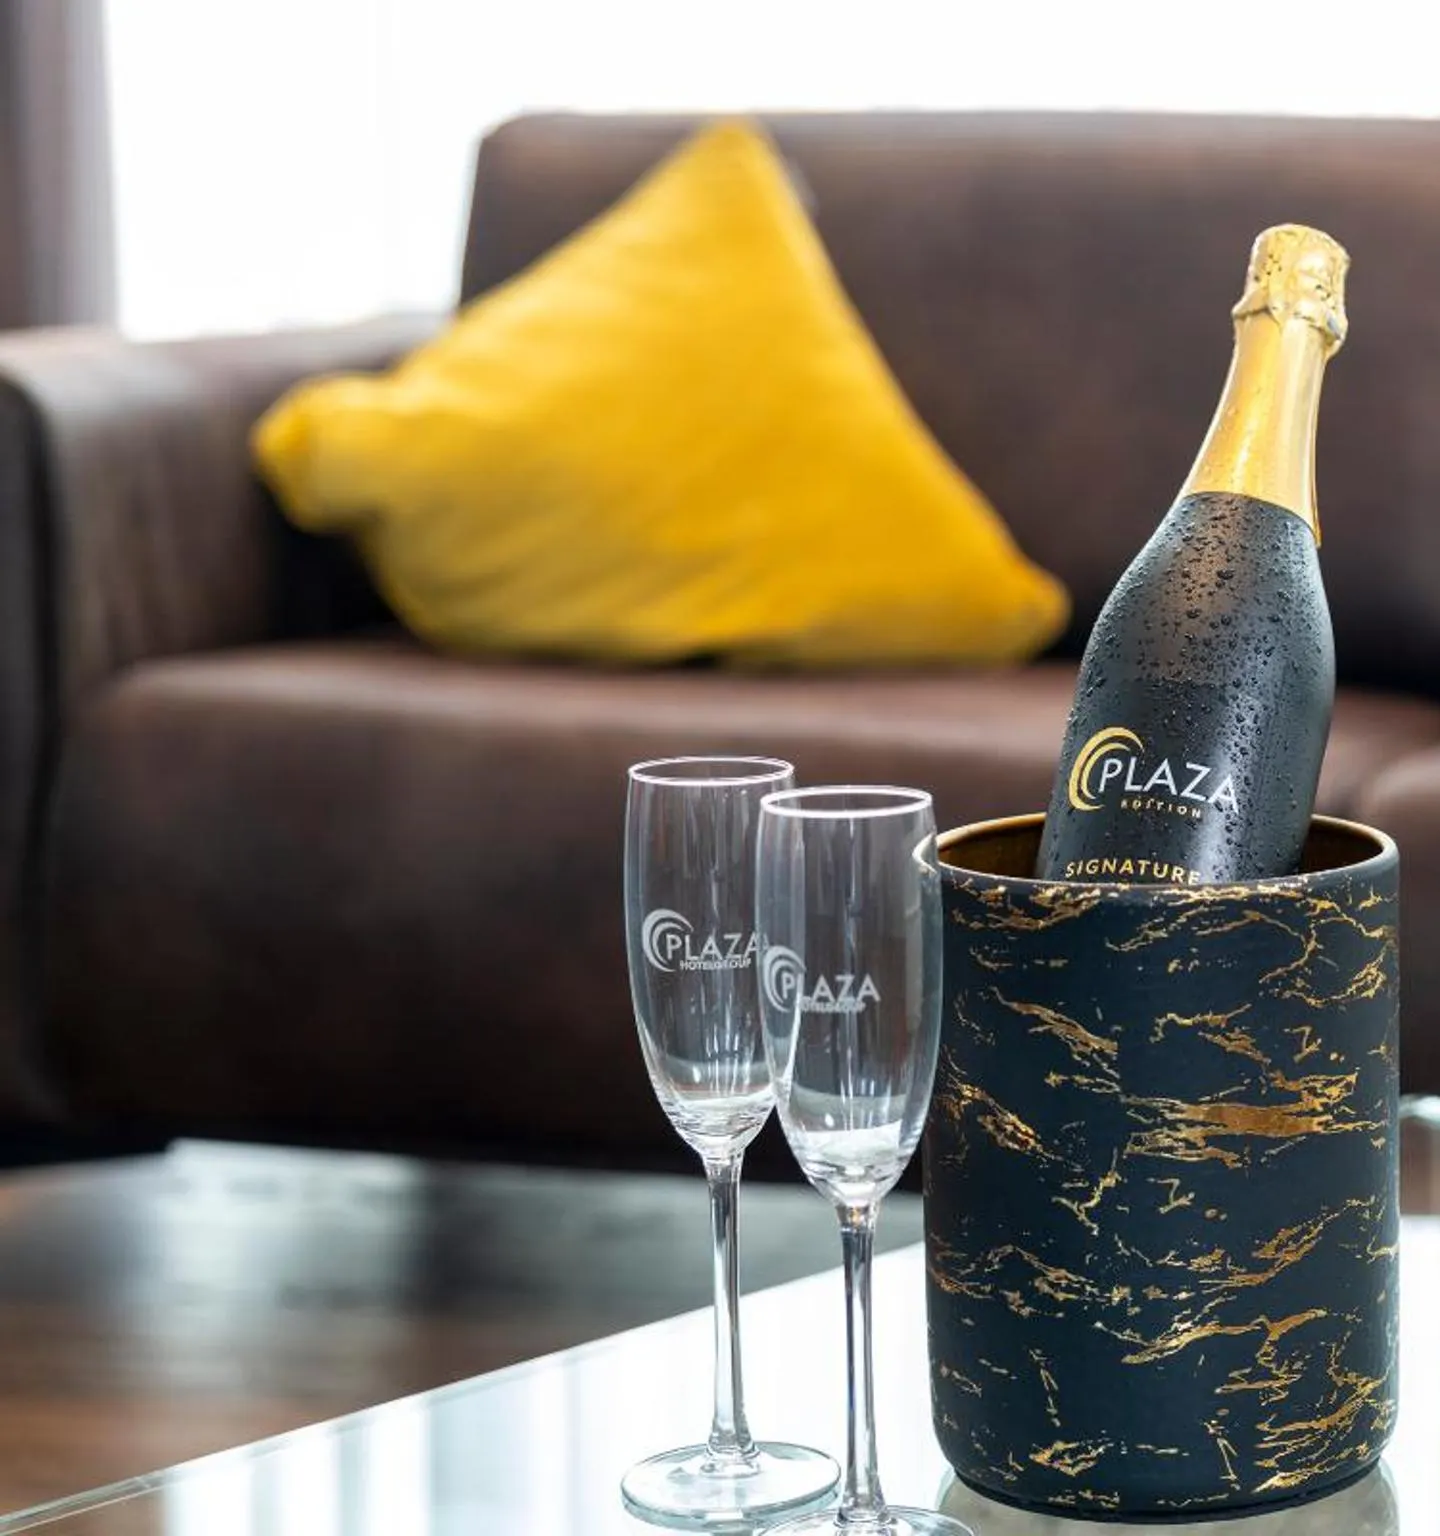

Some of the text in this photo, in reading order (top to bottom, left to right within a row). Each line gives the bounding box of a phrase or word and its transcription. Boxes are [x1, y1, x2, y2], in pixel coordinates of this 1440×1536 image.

[1098, 757, 1239, 814] PLAZA
[1064, 858, 1201, 886] SIGNATURE
[665, 932, 763, 961] PLAZA
[781, 974, 880, 1002] PLAZA
